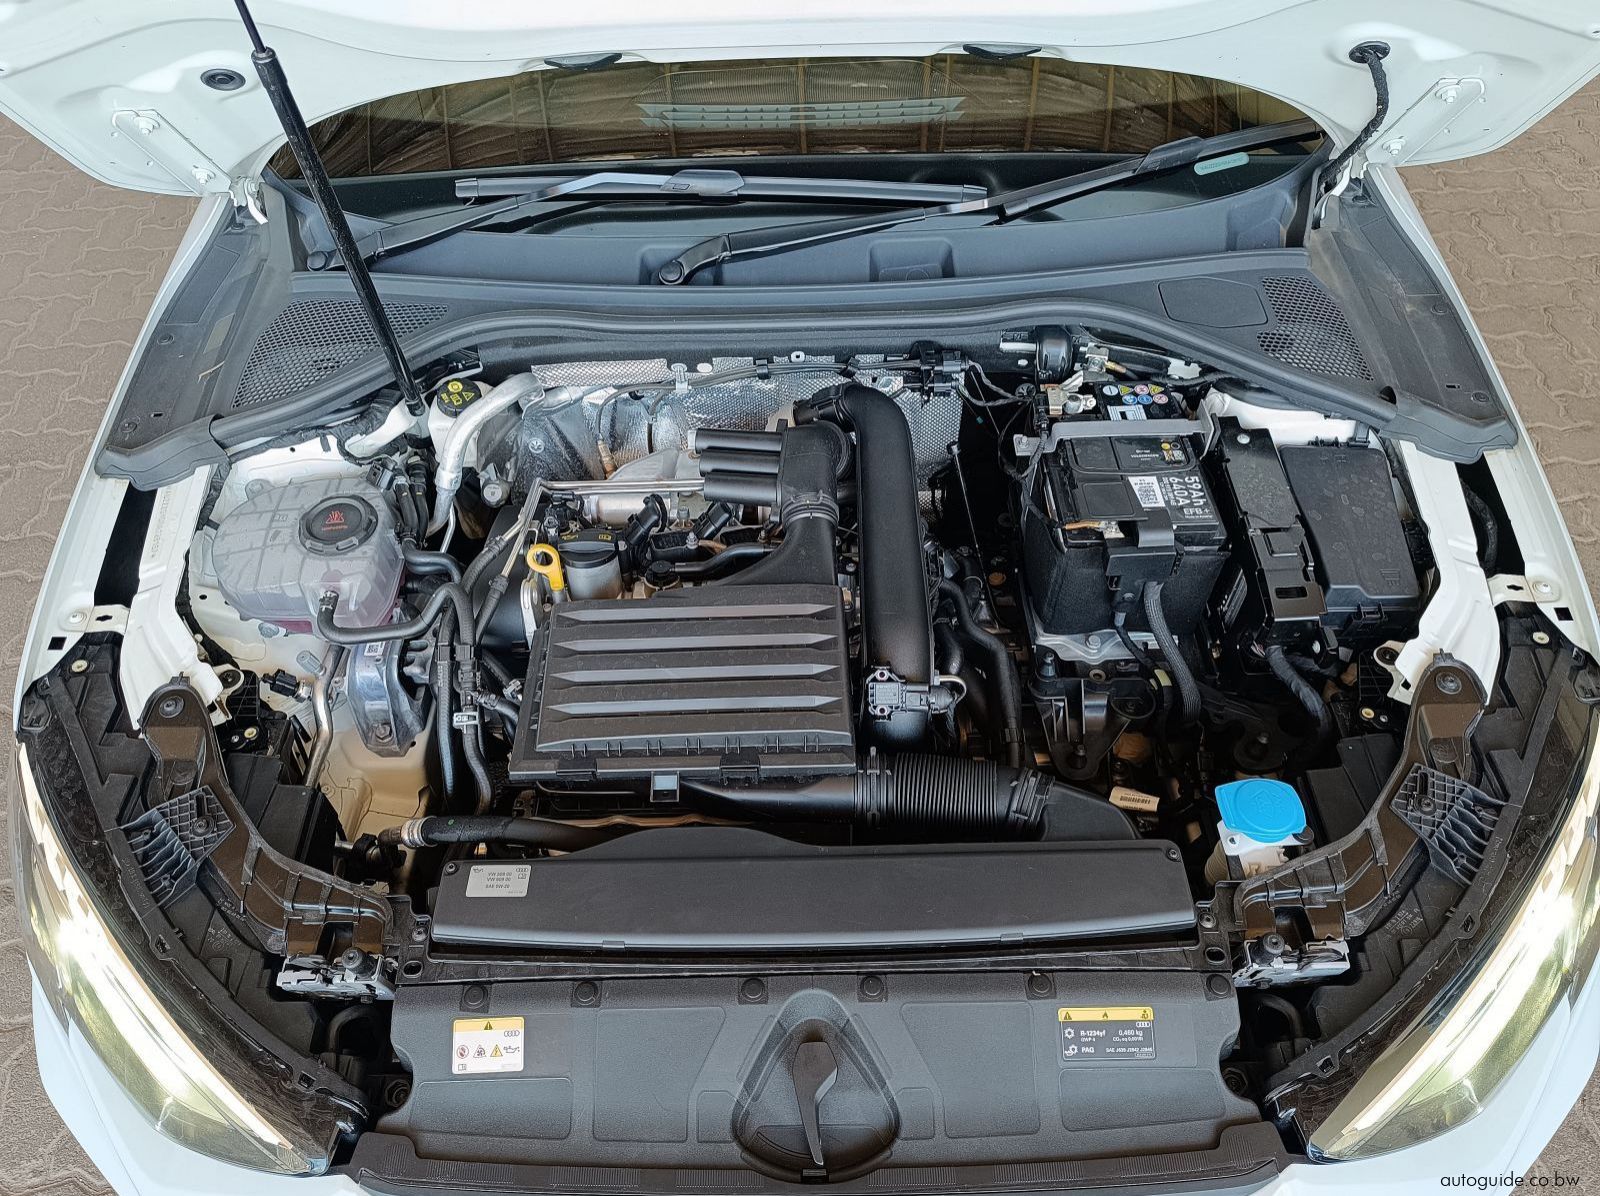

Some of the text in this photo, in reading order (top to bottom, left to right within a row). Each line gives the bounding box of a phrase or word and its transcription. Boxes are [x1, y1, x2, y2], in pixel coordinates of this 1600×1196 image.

[1169, 476, 1191, 506] 640A
[1184, 475, 1207, 506] 59Ah
[1183, 507, 1203, 515] EFB
[1135, 1029, 1143, 1037] kg
